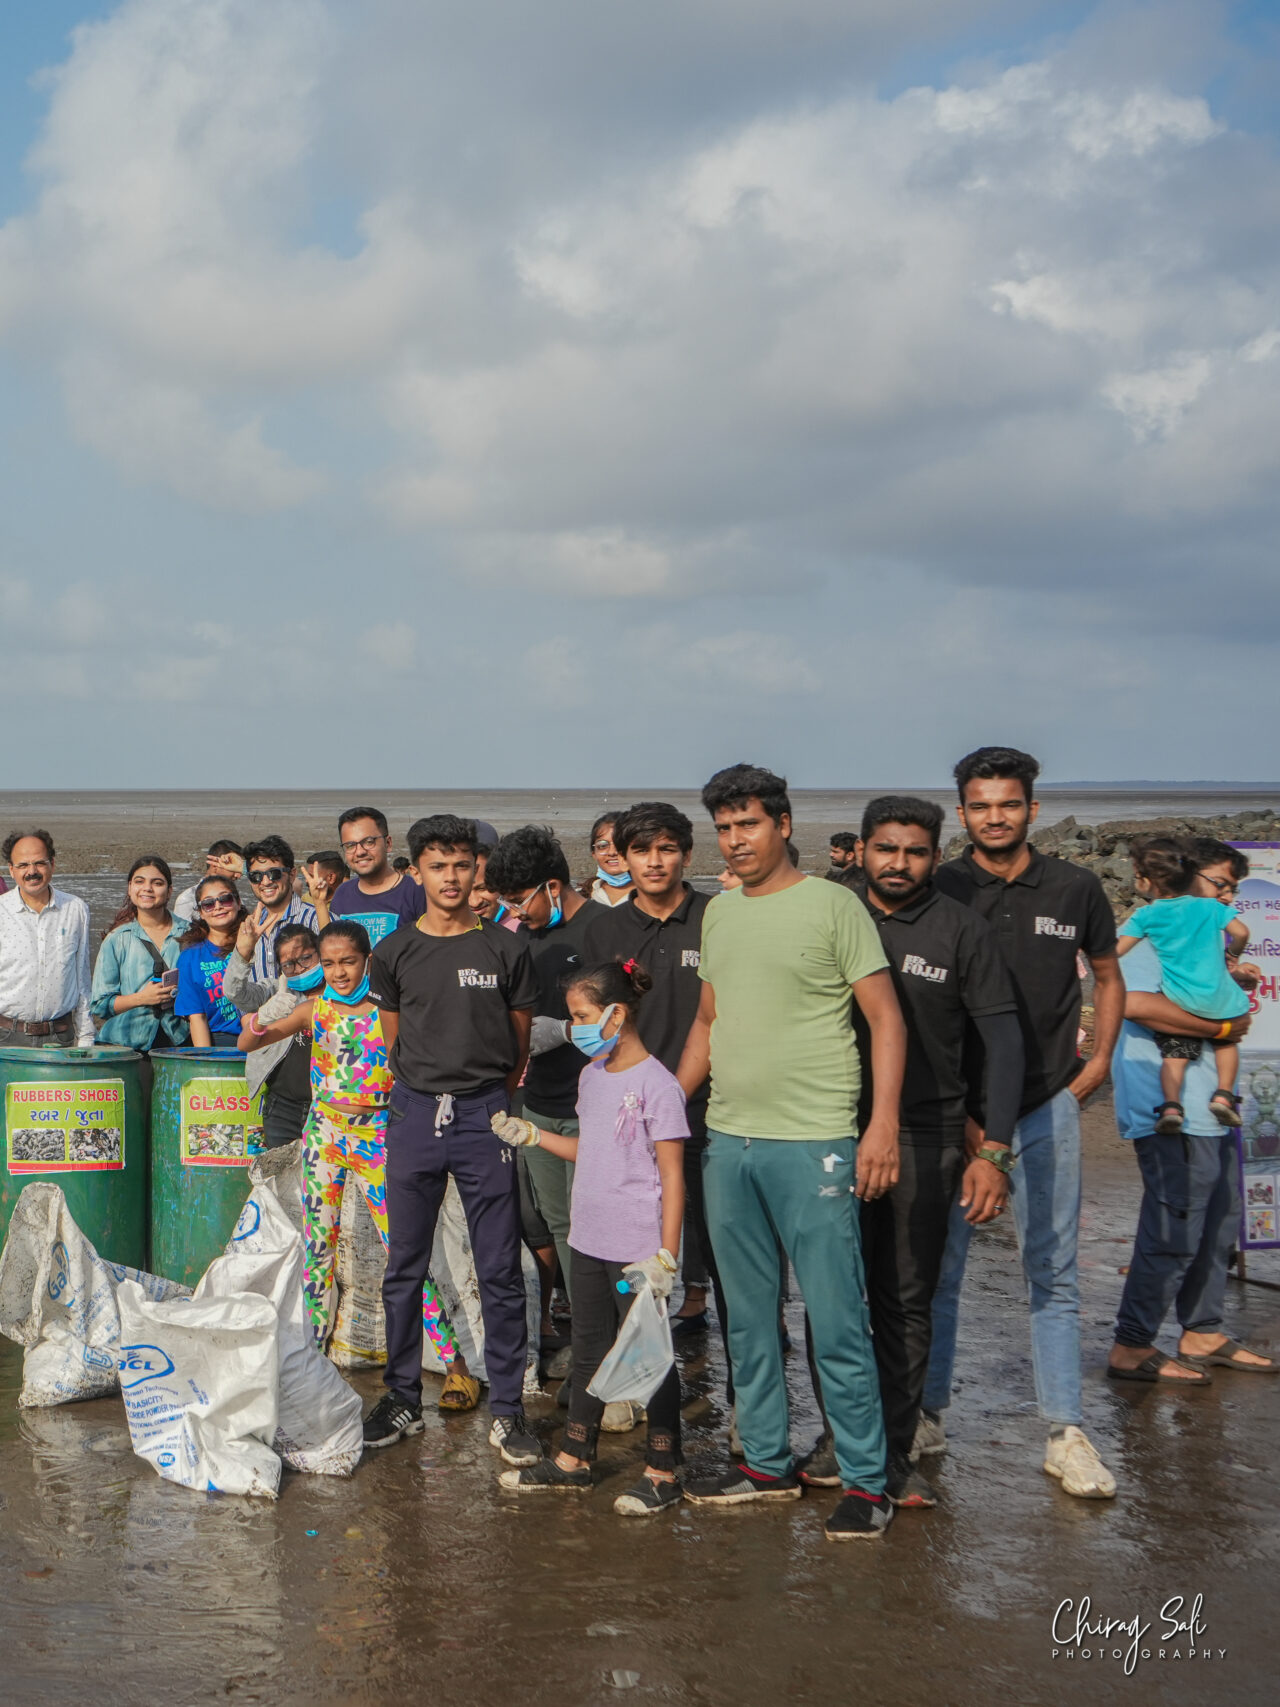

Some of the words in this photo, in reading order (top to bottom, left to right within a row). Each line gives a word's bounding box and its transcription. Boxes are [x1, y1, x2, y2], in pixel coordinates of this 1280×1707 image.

[1034, 923, 1076, 937] FOJJI
[901, 961, 948, 981] FOJJI
[459, 974, 498, 987] FOJJI
[79, 1089, 119, 1102] SHOES
[189, 1095, 251, 1112] GLASS
[30, 1110, 59, 1121] રબર
[75, 1110, 104, 1126] જુતા
[131, 1395, 163, 1409] BASICITY
[146, 1404, 168, 1417] POWDER
